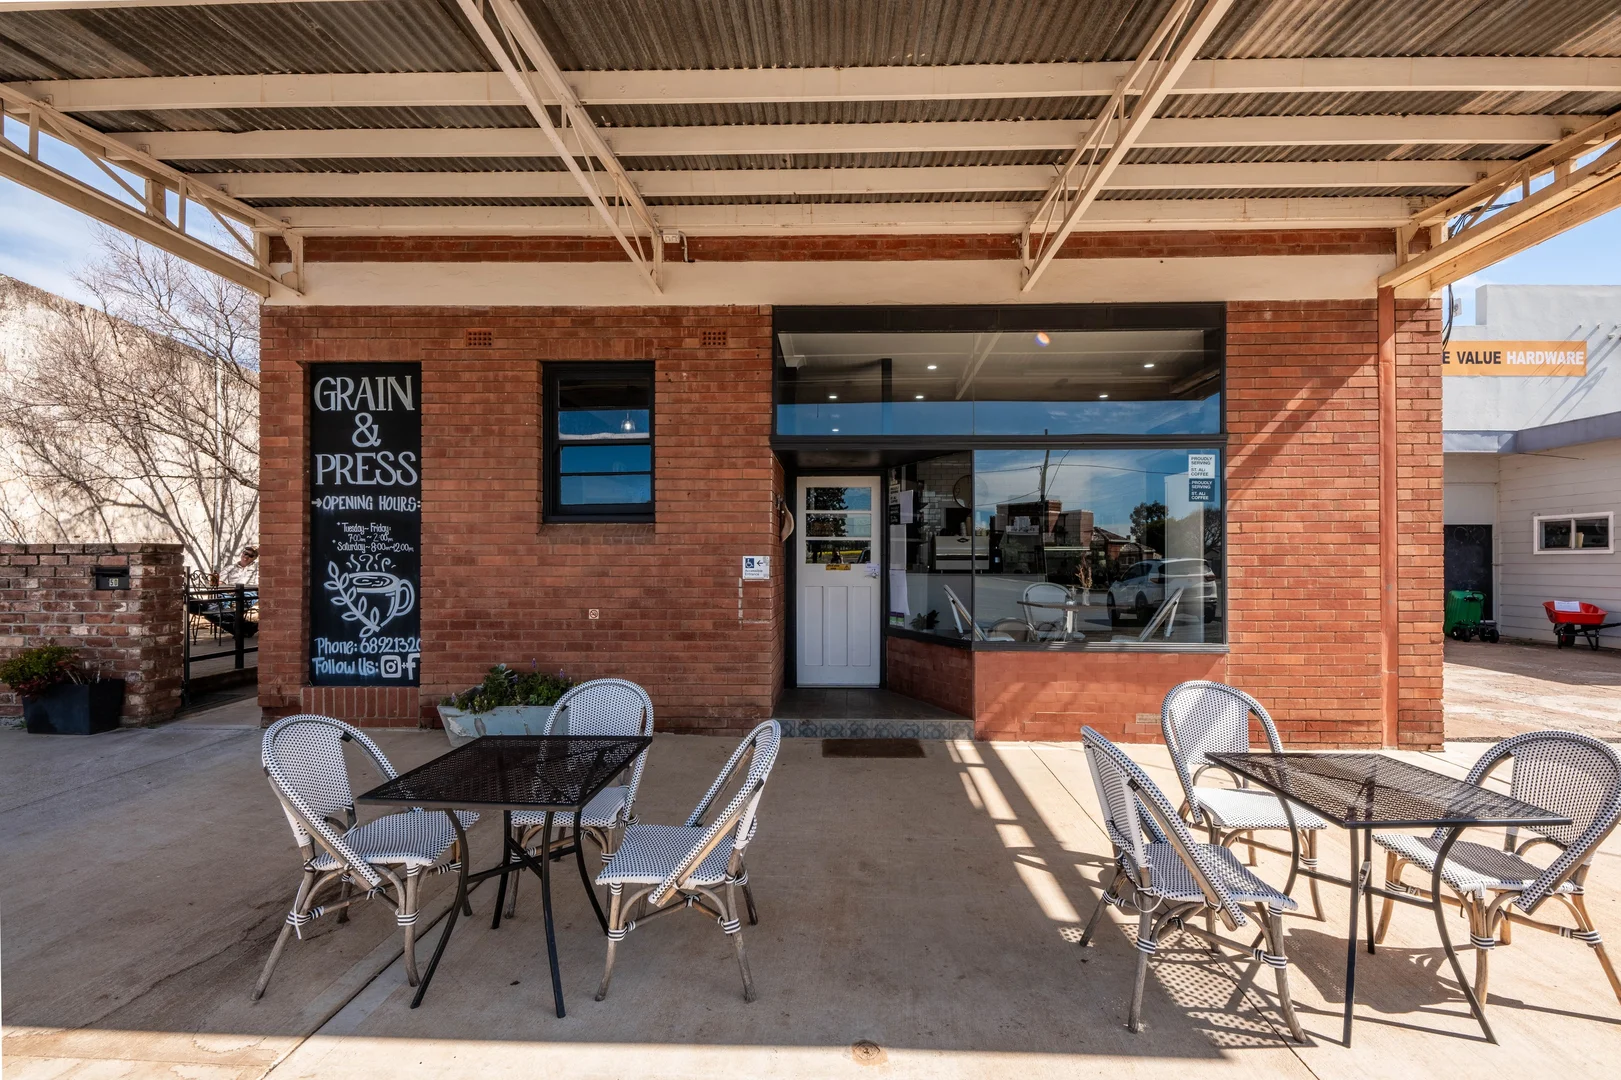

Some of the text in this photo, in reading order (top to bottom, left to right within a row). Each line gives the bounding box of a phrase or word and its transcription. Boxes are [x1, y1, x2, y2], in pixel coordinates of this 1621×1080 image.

[1456, 351, 1501, 364] VALUE
[1507, 351, 1584, 365] HARDWARE
[314, 375, 415, 411] GRAIN
[351, 412, 381, 448] &
[315, 451, 418, 486] PRESS
[322, 495, 421, 512] OPENING HOURS:
[314, 637, 358, 656] Phone:
[312, 657, 355, 676] Follow
[358, 657, 379, 675] Us:
